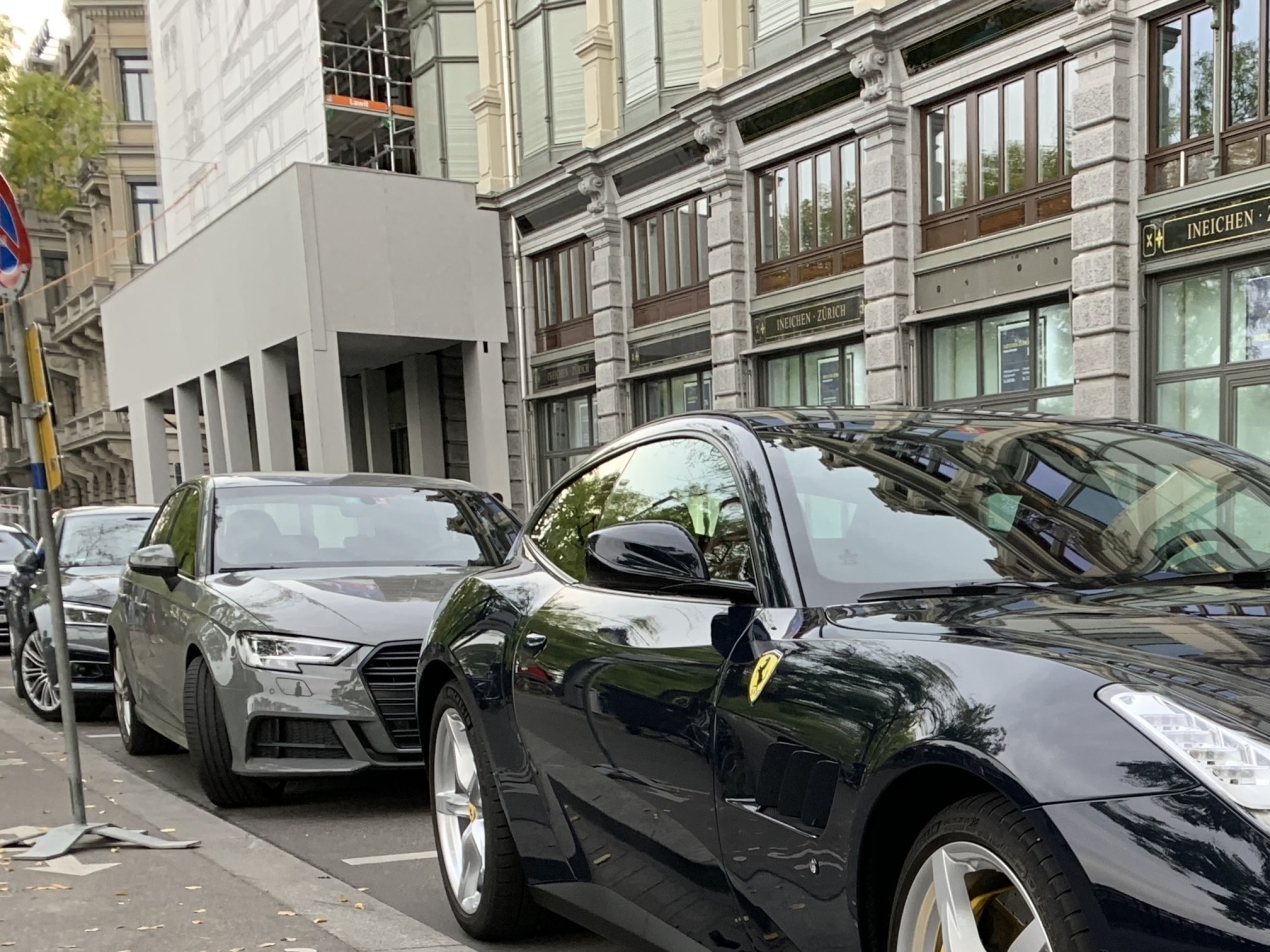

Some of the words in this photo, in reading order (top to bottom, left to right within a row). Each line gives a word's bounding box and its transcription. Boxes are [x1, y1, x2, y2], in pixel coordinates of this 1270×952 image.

[1187, 208, 1254, 240] INEICHEN
[776, 311, 811, 331] INEICHEN
[816, 304, 846, 322] ZÜRICH
